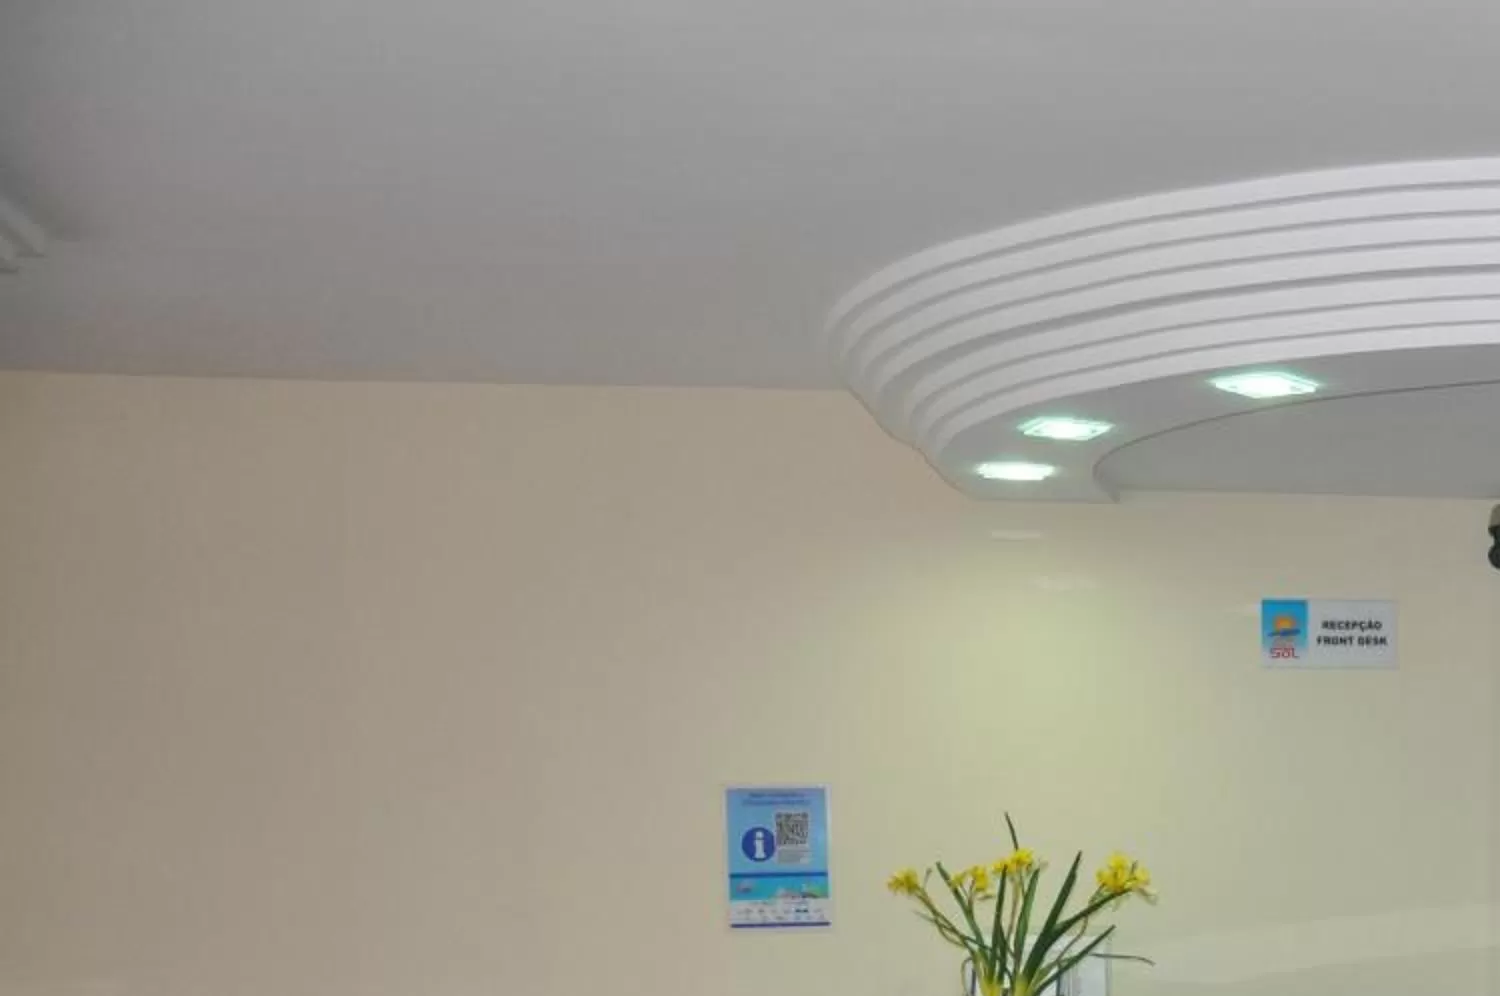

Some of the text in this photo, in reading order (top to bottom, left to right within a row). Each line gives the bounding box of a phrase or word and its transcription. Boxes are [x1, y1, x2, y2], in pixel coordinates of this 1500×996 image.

[1321, 619, 1382, 631] RECEPÇÃO
[1316, 635, 1388, 645] FRONT DESK
[1269, 647, 1299, 659] SOL
